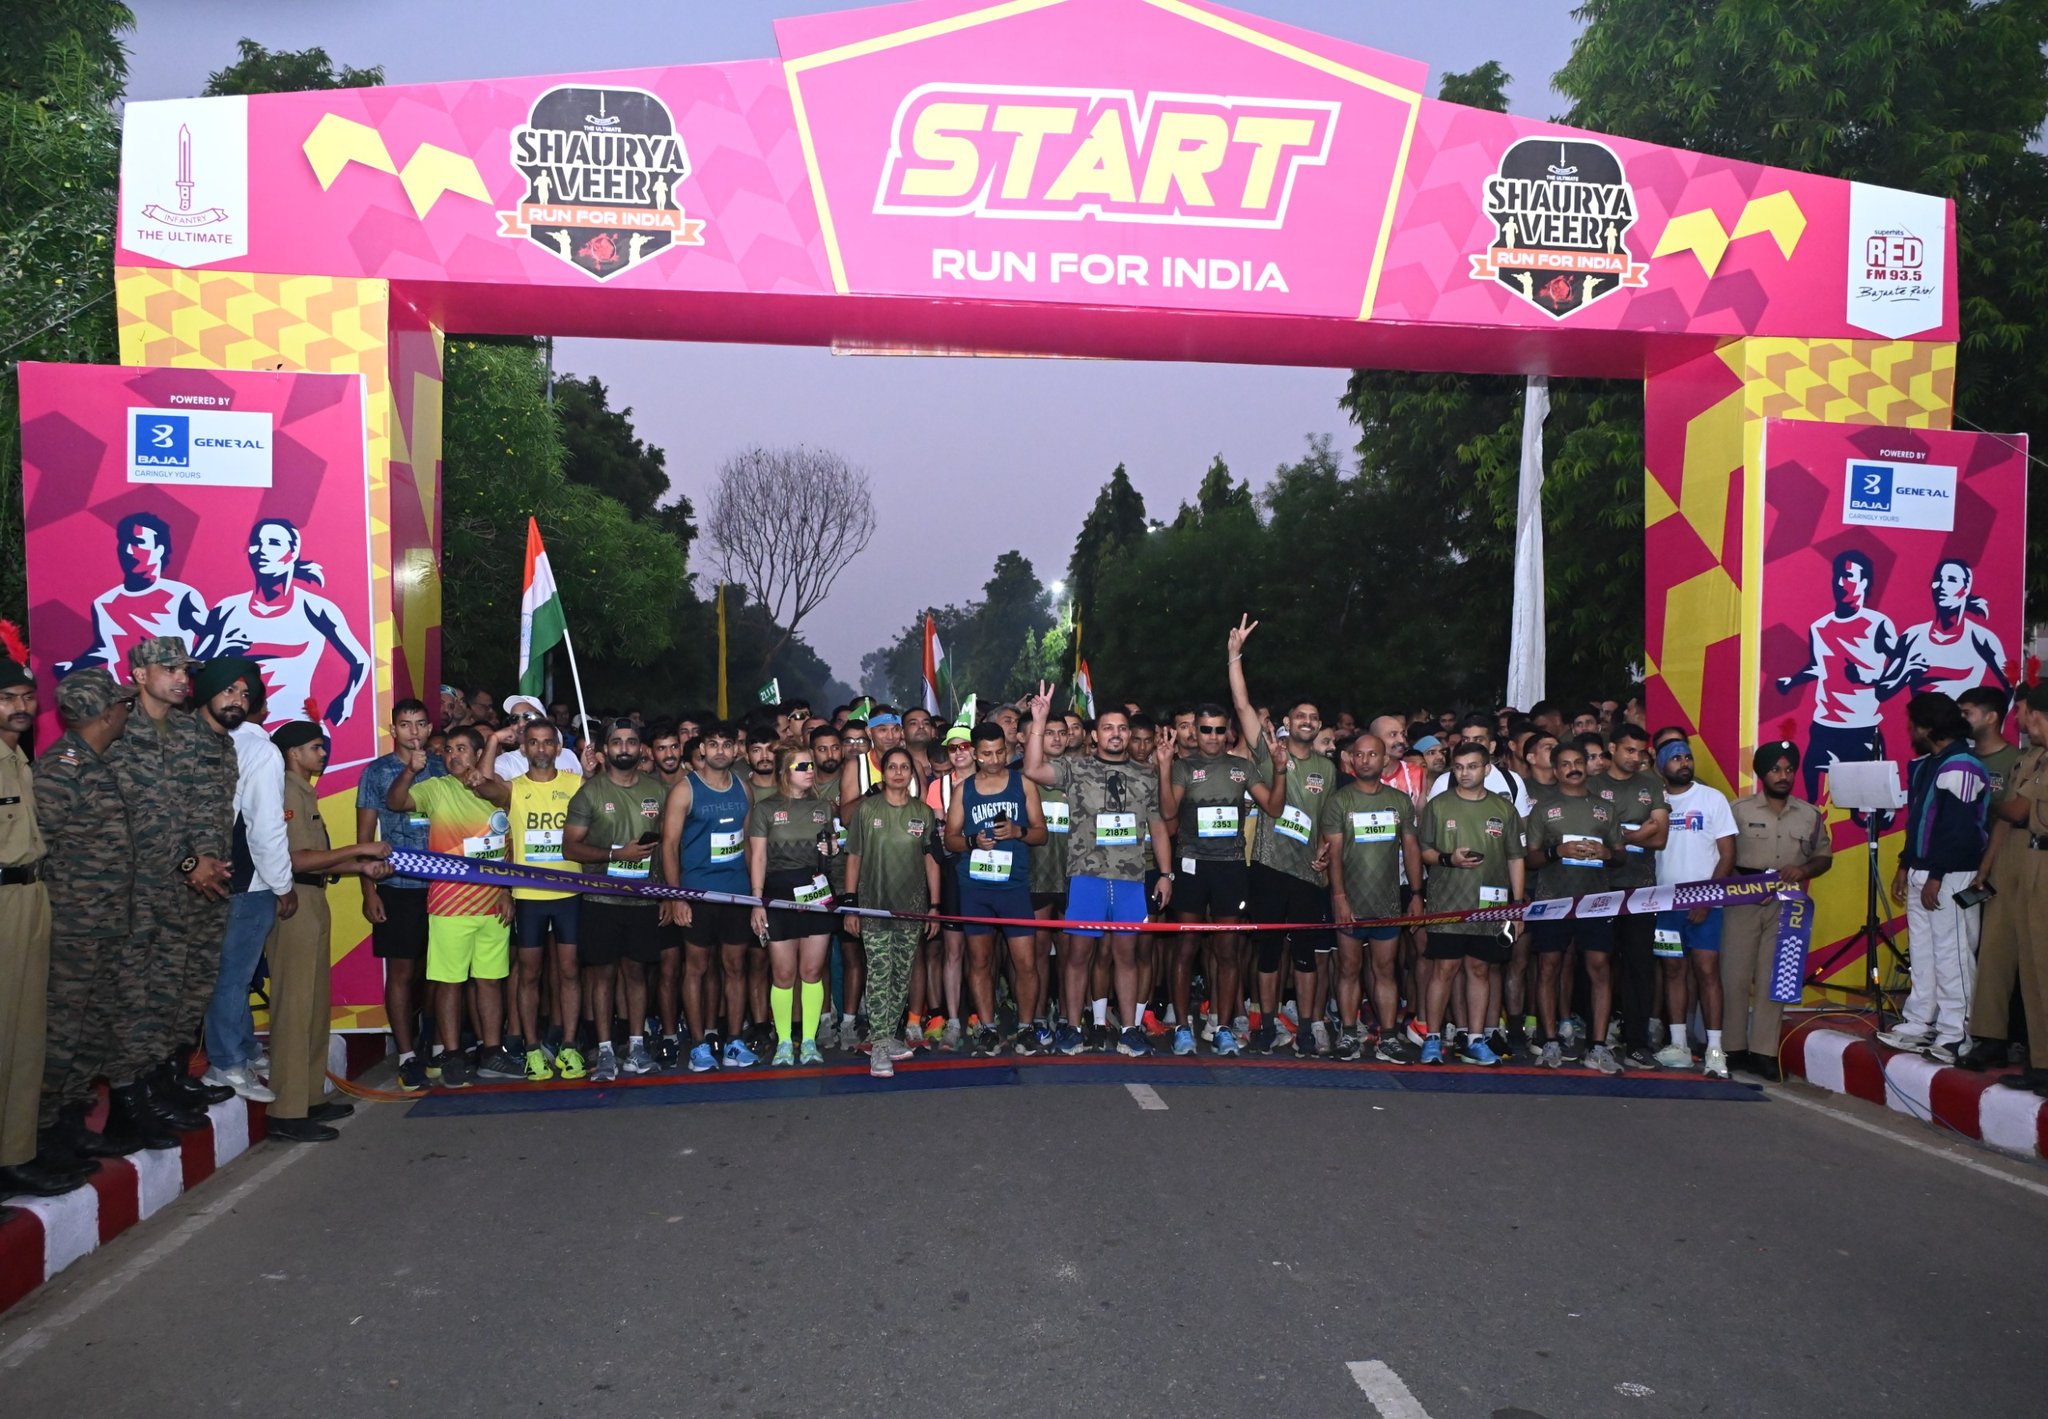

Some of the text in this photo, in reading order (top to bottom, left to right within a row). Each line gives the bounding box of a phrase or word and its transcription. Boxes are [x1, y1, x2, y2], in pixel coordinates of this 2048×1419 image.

[516, 131, 685, 170] SHAURYA
[899, 101, 1317, 209] START
[553, 166, 648, 201] VEER
[1488, 180, 1633, 217] SHAURYA
[163, 213, 208, 225] INFANTRY
[528, 207, 675, 227] RUN FOR INDIA
[1520, 213, 1601, 245] VEER
[137, 230, 233, 244] THE ULTIMATE
[1867, 236, 1923, 268] RED
[1497, 253, 1623, 270] RUN FOR INDIA
[932, 247, 1290, 293] RUN FOR INDIA
[1866, 269, 1922, 281] FM 93.5
[170, 395, 230, 406] POWERED BY
[194, 437, 265, 449] GENERAL
[137, 455, 187, 465] BAJAJ
[1880, 449, 1926, 460] POWERED BY
[135, 469, 201, 479] CARINGLY YOURS
[1896, 487, 1949, 498] GENERAL
[1851, 500, 1890, 511] BAJAJ
[1105, 828, 1129, 837] 21875
[1281, 819, 1304, 834] 21368
[1364, 825, 1386, 834] 21617
[534, 844, 561, 853] 22077
[480, 865, 524, 879] RUN
[979, 864, 1002, 873] 2180
[1726, 881, 1801, 896] RUN FOR
